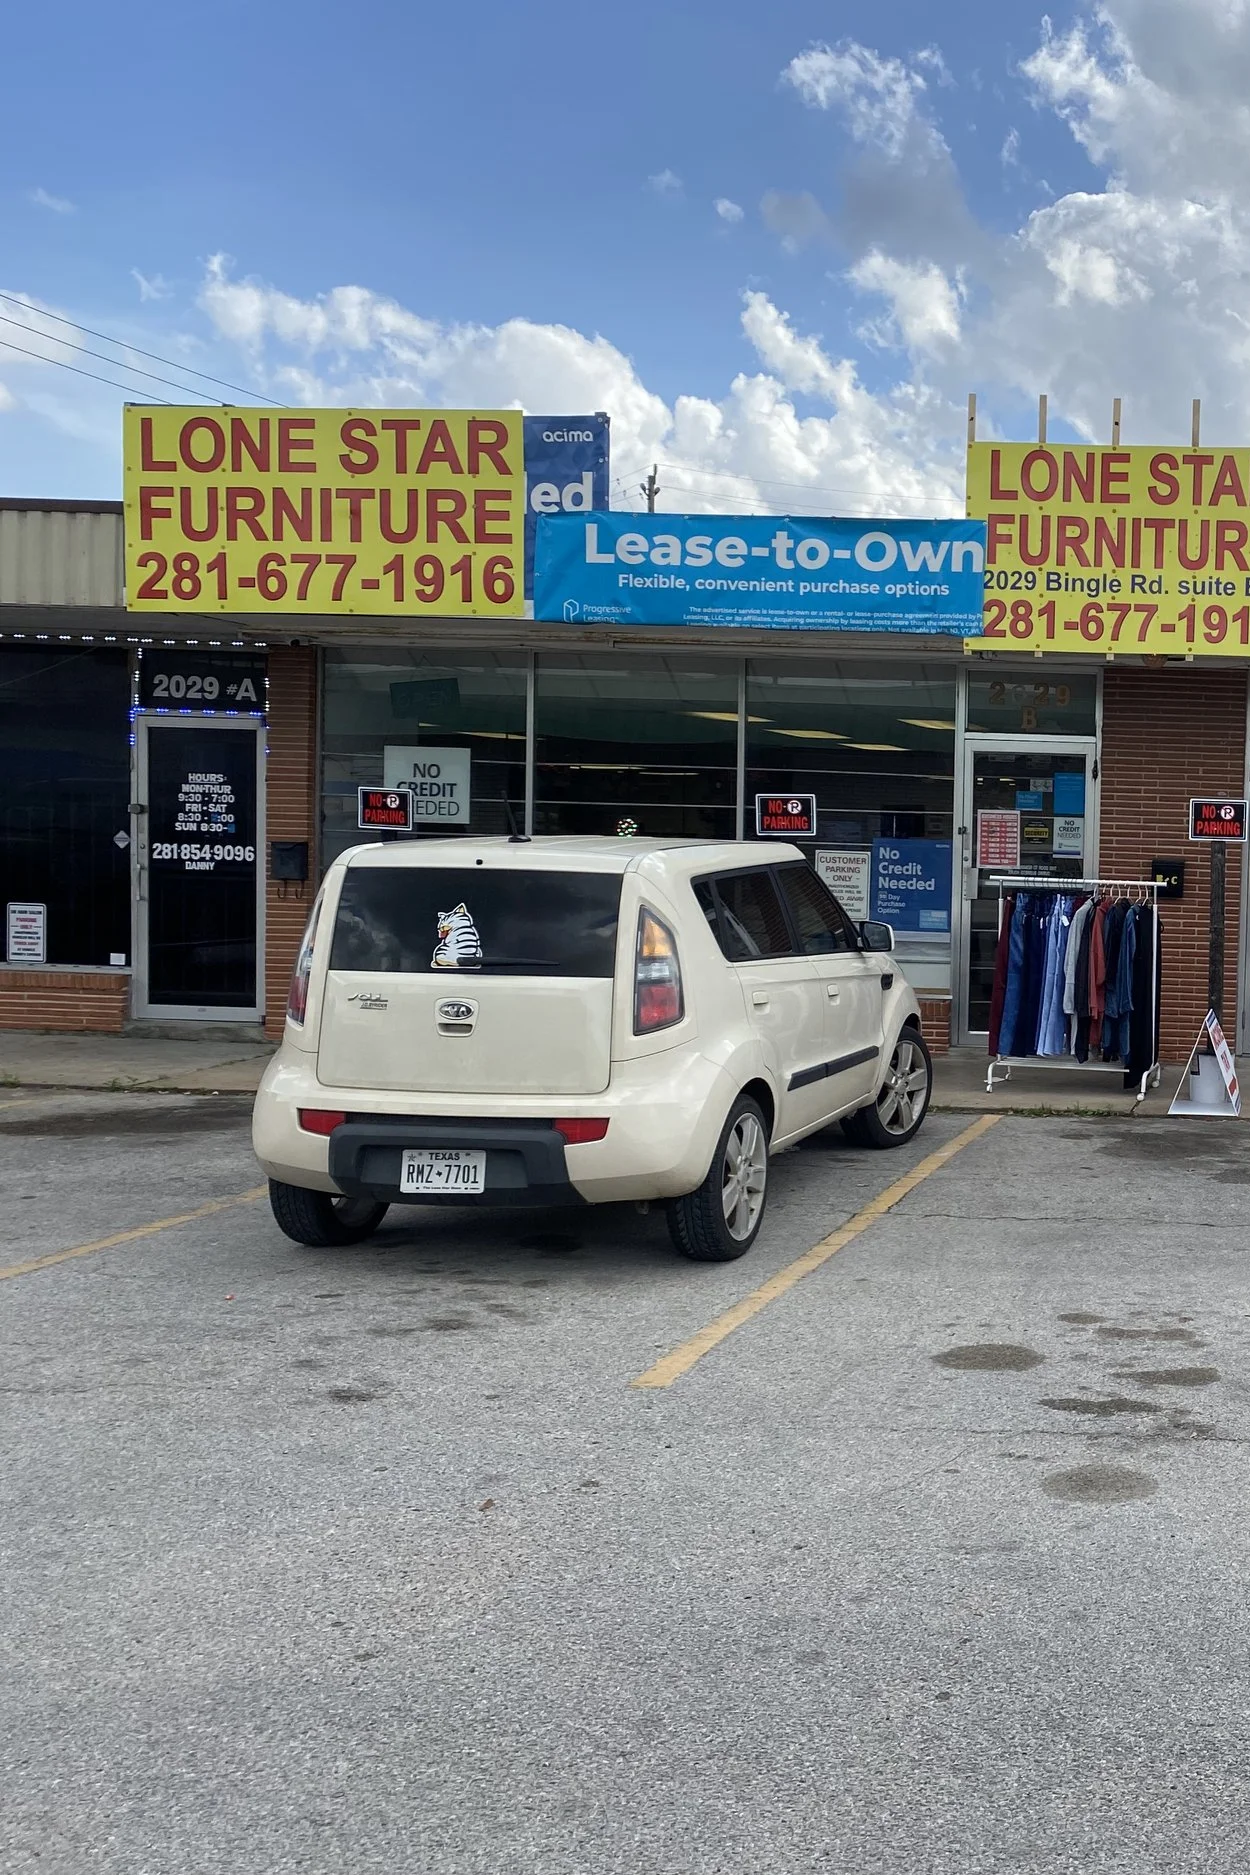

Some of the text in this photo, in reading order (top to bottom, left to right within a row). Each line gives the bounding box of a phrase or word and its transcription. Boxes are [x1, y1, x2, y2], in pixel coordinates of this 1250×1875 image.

[542, 428, 594, 443] acima
[140, 417, 512, 475] LONE STAR
[990, 449, 1131, 504] LONE
[524, 471, 594, 513] ed
[138, 486, 513, 544] FURNITURE
[585, 523, 983, 572] Lease-to-Own
[136, 551, 515, 604] 281-677-1916
[983, 570, 1036, 591] 2029
[1046, 573, 1122, 598] Bingle
[1130, 574, 1168, 595] Rd.
[1179, 576, 1236, 596] suite
[618, 574, 949, 598] Flexible, convenient purchase options
[583, 604, 632, 614] Progressive
[152, 674, 257, 702] 2029 #A
[412, 762, 441, 778] NO
[188, 773, 227, 783] HOURS:
[181, 784, 231, 794] MON-THUR
[397, 781, 457, 798] CREDIT
[178, 793, 235, 803] 9:30 7:00
[369, 793, 382, 807] NO
[412, 800, 460, 816] EDED
[768, 800, 783, 813] NO
[1202, 805, 1216, 819] NO
[177, 813, 235, 822] 8:30 :00
[364, 809, 405, 824] PARKING
[763, 816, 808, 830] PARKING
[175, 822, 197, 831] SUN
[1196, 821, 1241, 836] PARKING
[819, 856, 867, 865] CUSTOMER
[879, 847, 900, 860] No
[185, 861, 215, 870] DANNY
[825, 865, 861, 874] PARKING
[878, 862, 922, 876] Credit
[878, 877, 935, 891] Needed
[888, 893, 901, 901] Day
[429, 1152, 460, 1161] TEXAS
[406, 1164, 479, 1184] RMZ 7701
